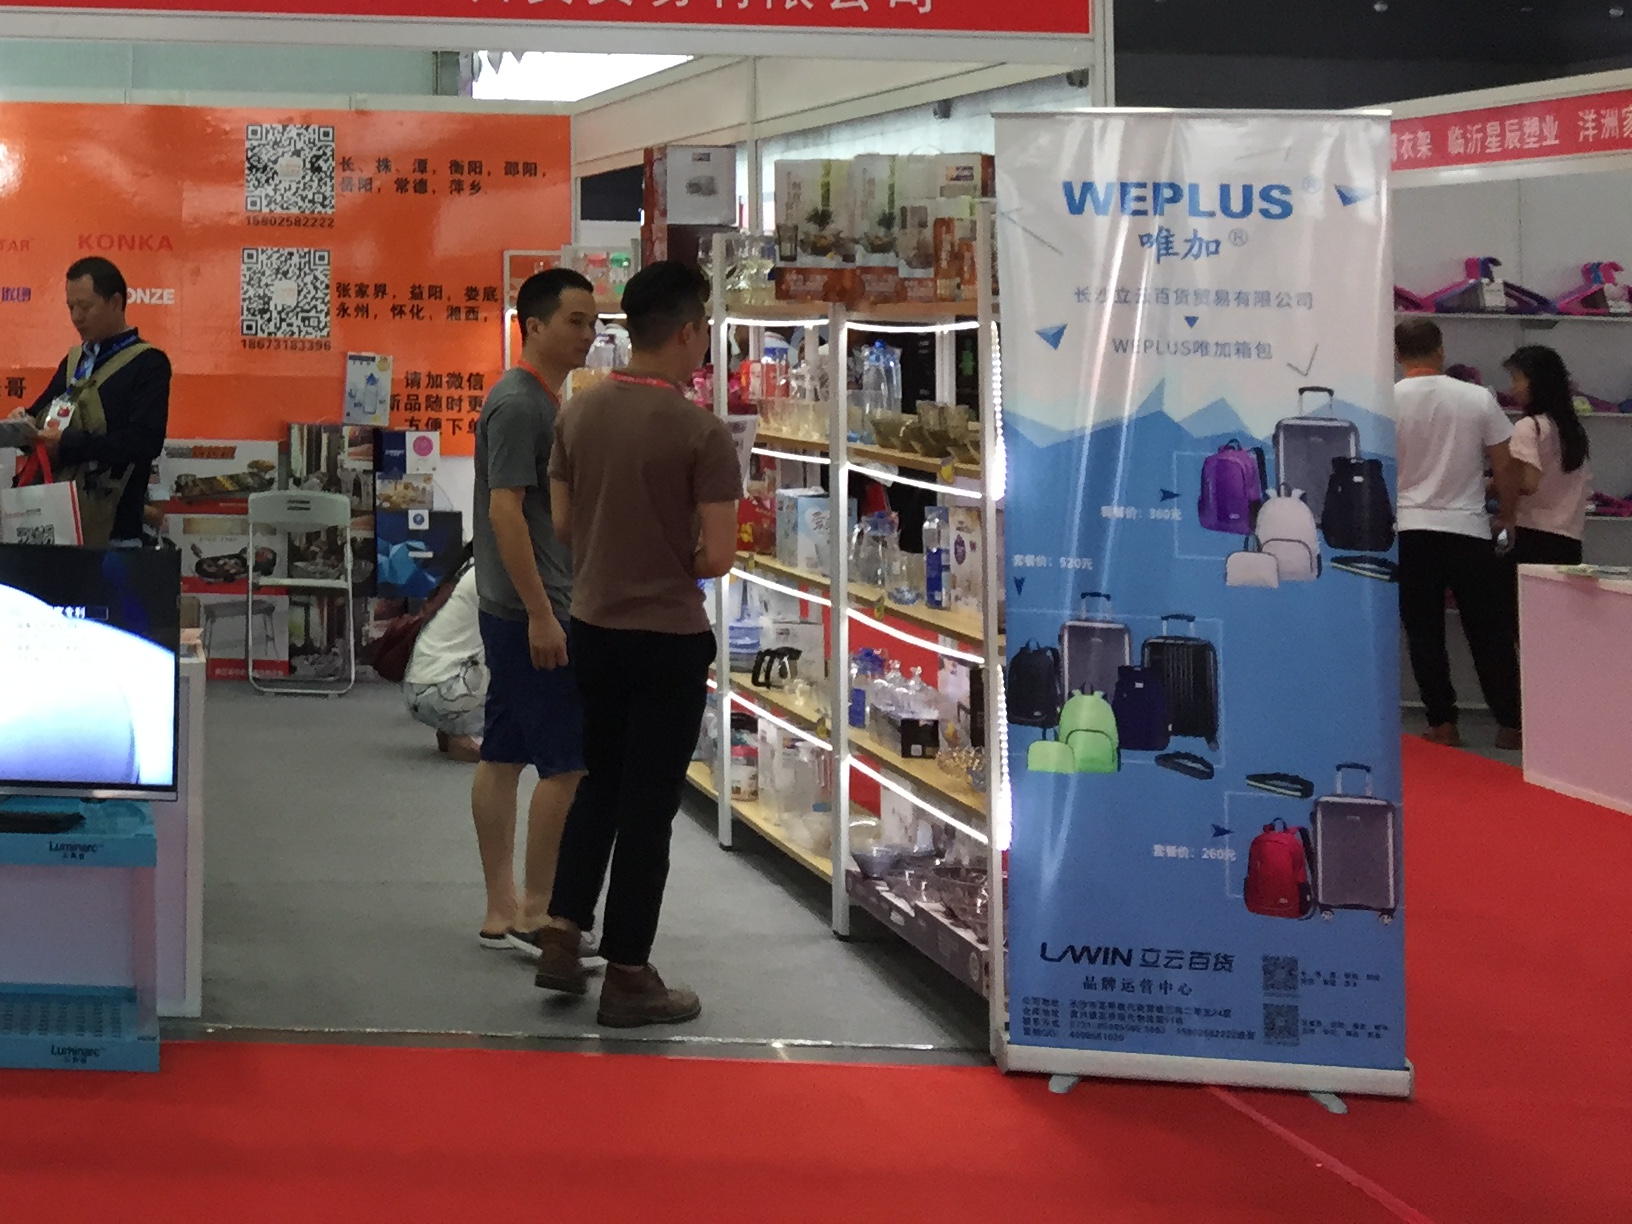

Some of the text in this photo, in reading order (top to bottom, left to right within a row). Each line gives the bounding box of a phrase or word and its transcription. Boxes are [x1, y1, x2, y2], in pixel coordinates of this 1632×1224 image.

[1062, 179, 1294, 220] WEPLUS
[77, 233, 174, 252] KONKA
[1138, 226, 1221, 264] 唯加
[1073, 286, 1314, 311] 长沙立云百货贸易有限公司
[1112, 336, 1273, 361] WEPLUS唯加箱包
[405, 370, 485, 392] 请加微信
[49, 841, 97, 853] Luminarc
[1040, 942, 1235, 973] LAWIN 立云百货
[1083, 976, 1193, 996] 品牌运营中心
[51, 1045, 101, 1057] Luminarc
